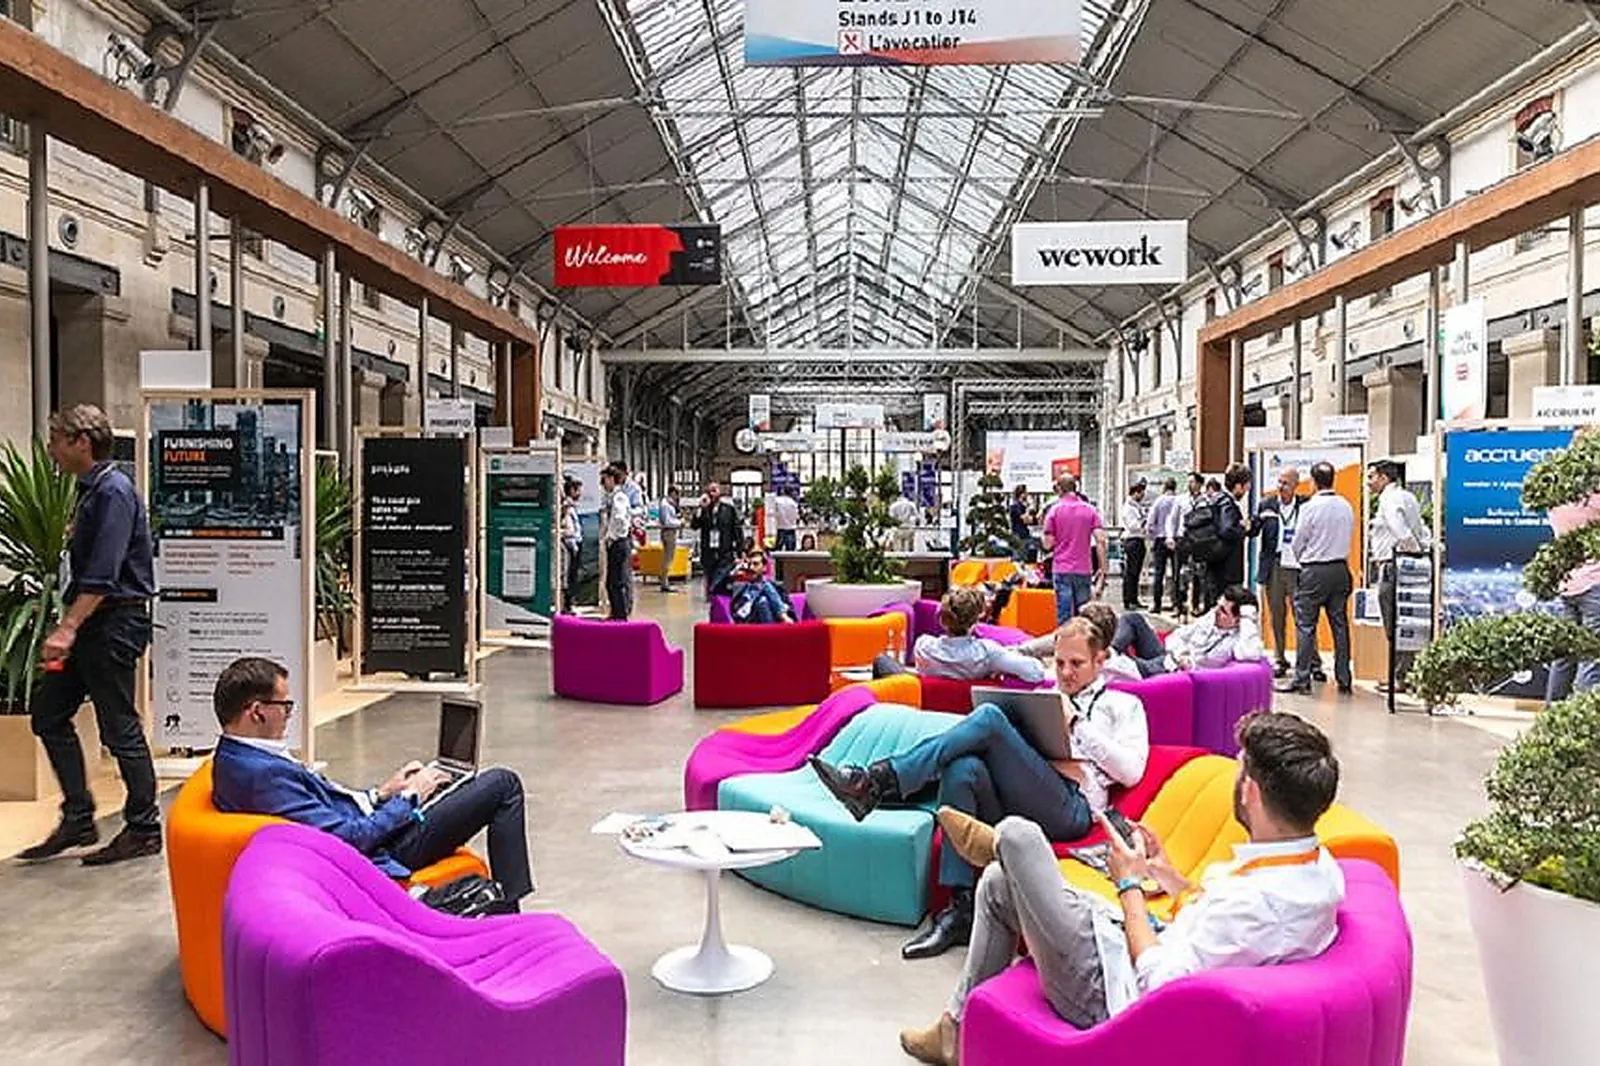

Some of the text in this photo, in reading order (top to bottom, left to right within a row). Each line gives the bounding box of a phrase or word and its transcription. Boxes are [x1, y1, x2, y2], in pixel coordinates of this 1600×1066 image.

[838, 9, 977, 27] Stands J1 to J14
[868, 33, 961, 51] L'avocatier
[564, 240, 649, 268] Welcome
[1038, 234, 1162, 267] wework
[163, 437, 234, 450] FURNISHING
[163, 450, 206, 462] FUTURE
